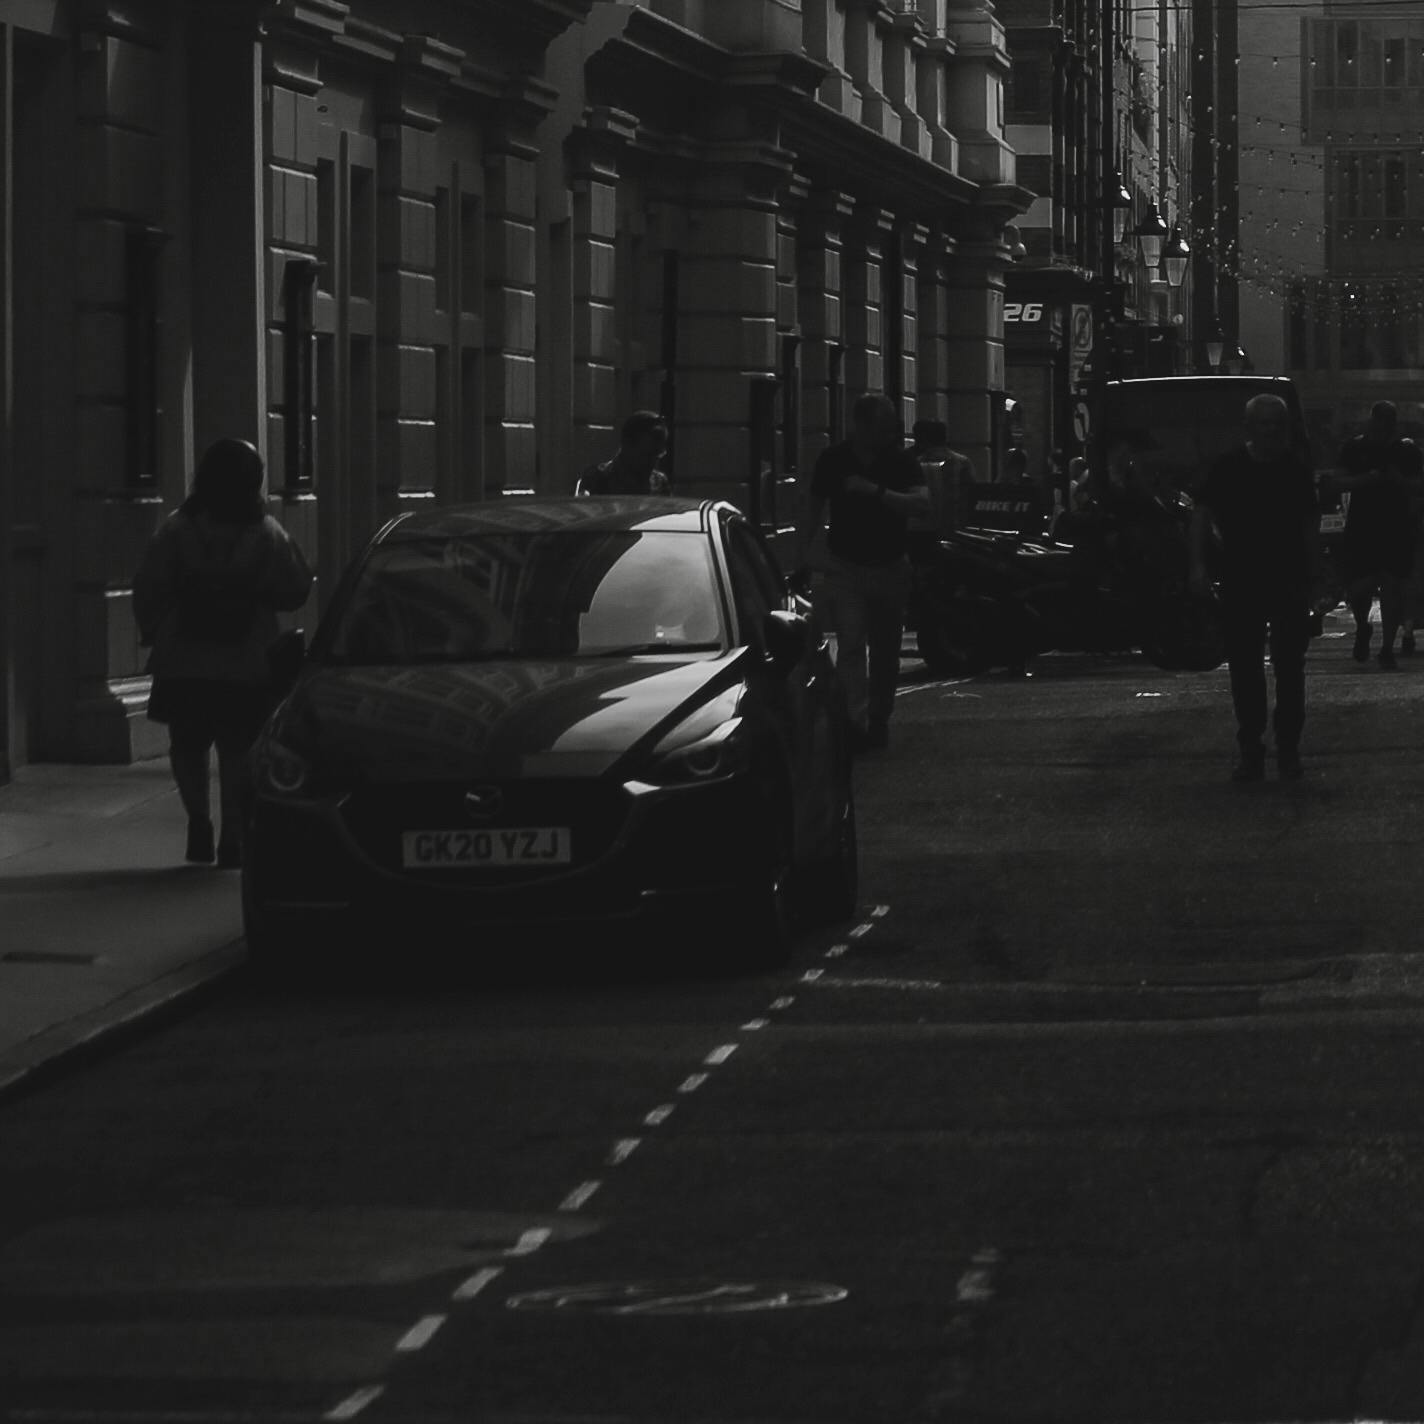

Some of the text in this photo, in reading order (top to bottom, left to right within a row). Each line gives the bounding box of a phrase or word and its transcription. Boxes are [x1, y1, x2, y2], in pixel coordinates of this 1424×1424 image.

[1003, 302, 1044, 323] 26
[415, 830, 559, 862] GK20 YZJ
